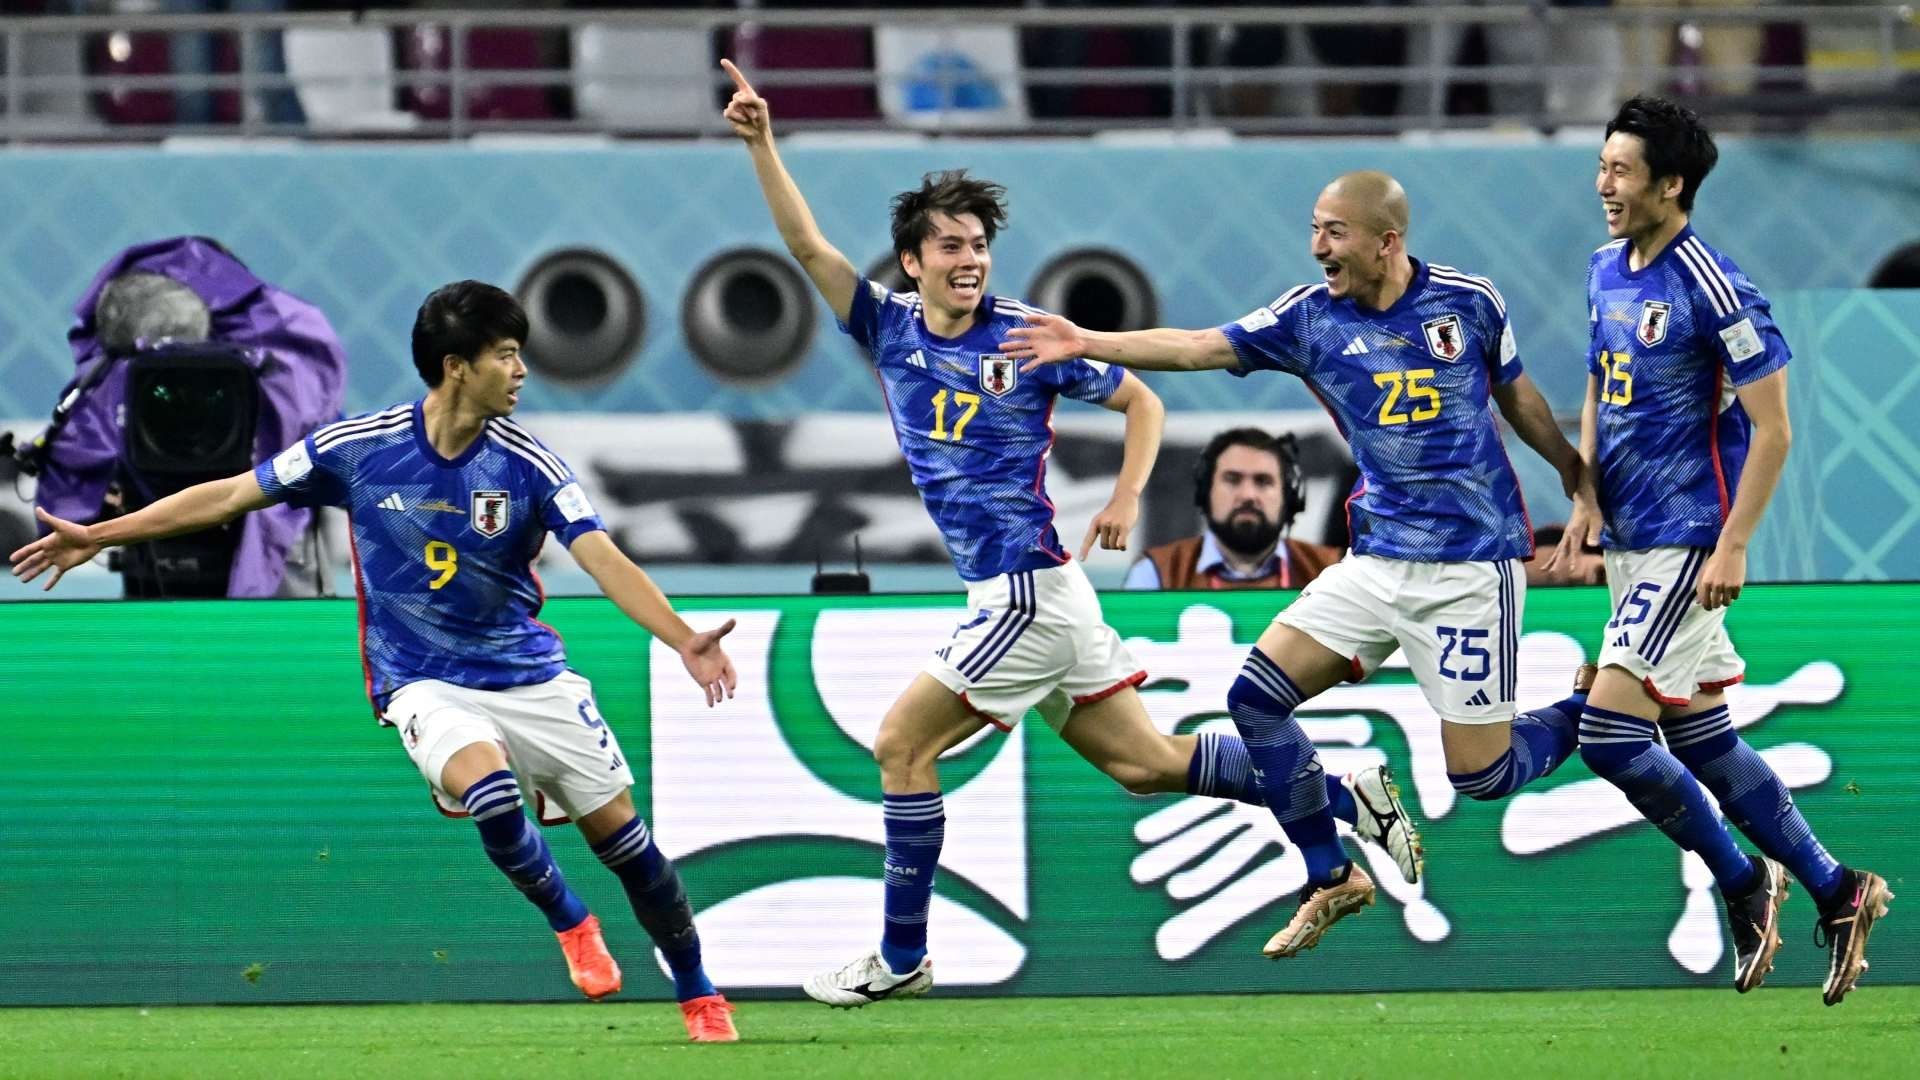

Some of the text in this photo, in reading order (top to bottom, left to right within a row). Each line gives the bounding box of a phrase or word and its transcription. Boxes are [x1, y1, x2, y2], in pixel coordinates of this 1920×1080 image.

[1374, 368, 1441, 425] 25
[1599, 350, 1633, 406] 15
[929, 388, 981, 441] 17
[425, 541, 457, 590] 9
[1608, 582, 1662, 628] 15
[1436, 626, 1490, 681] 25
